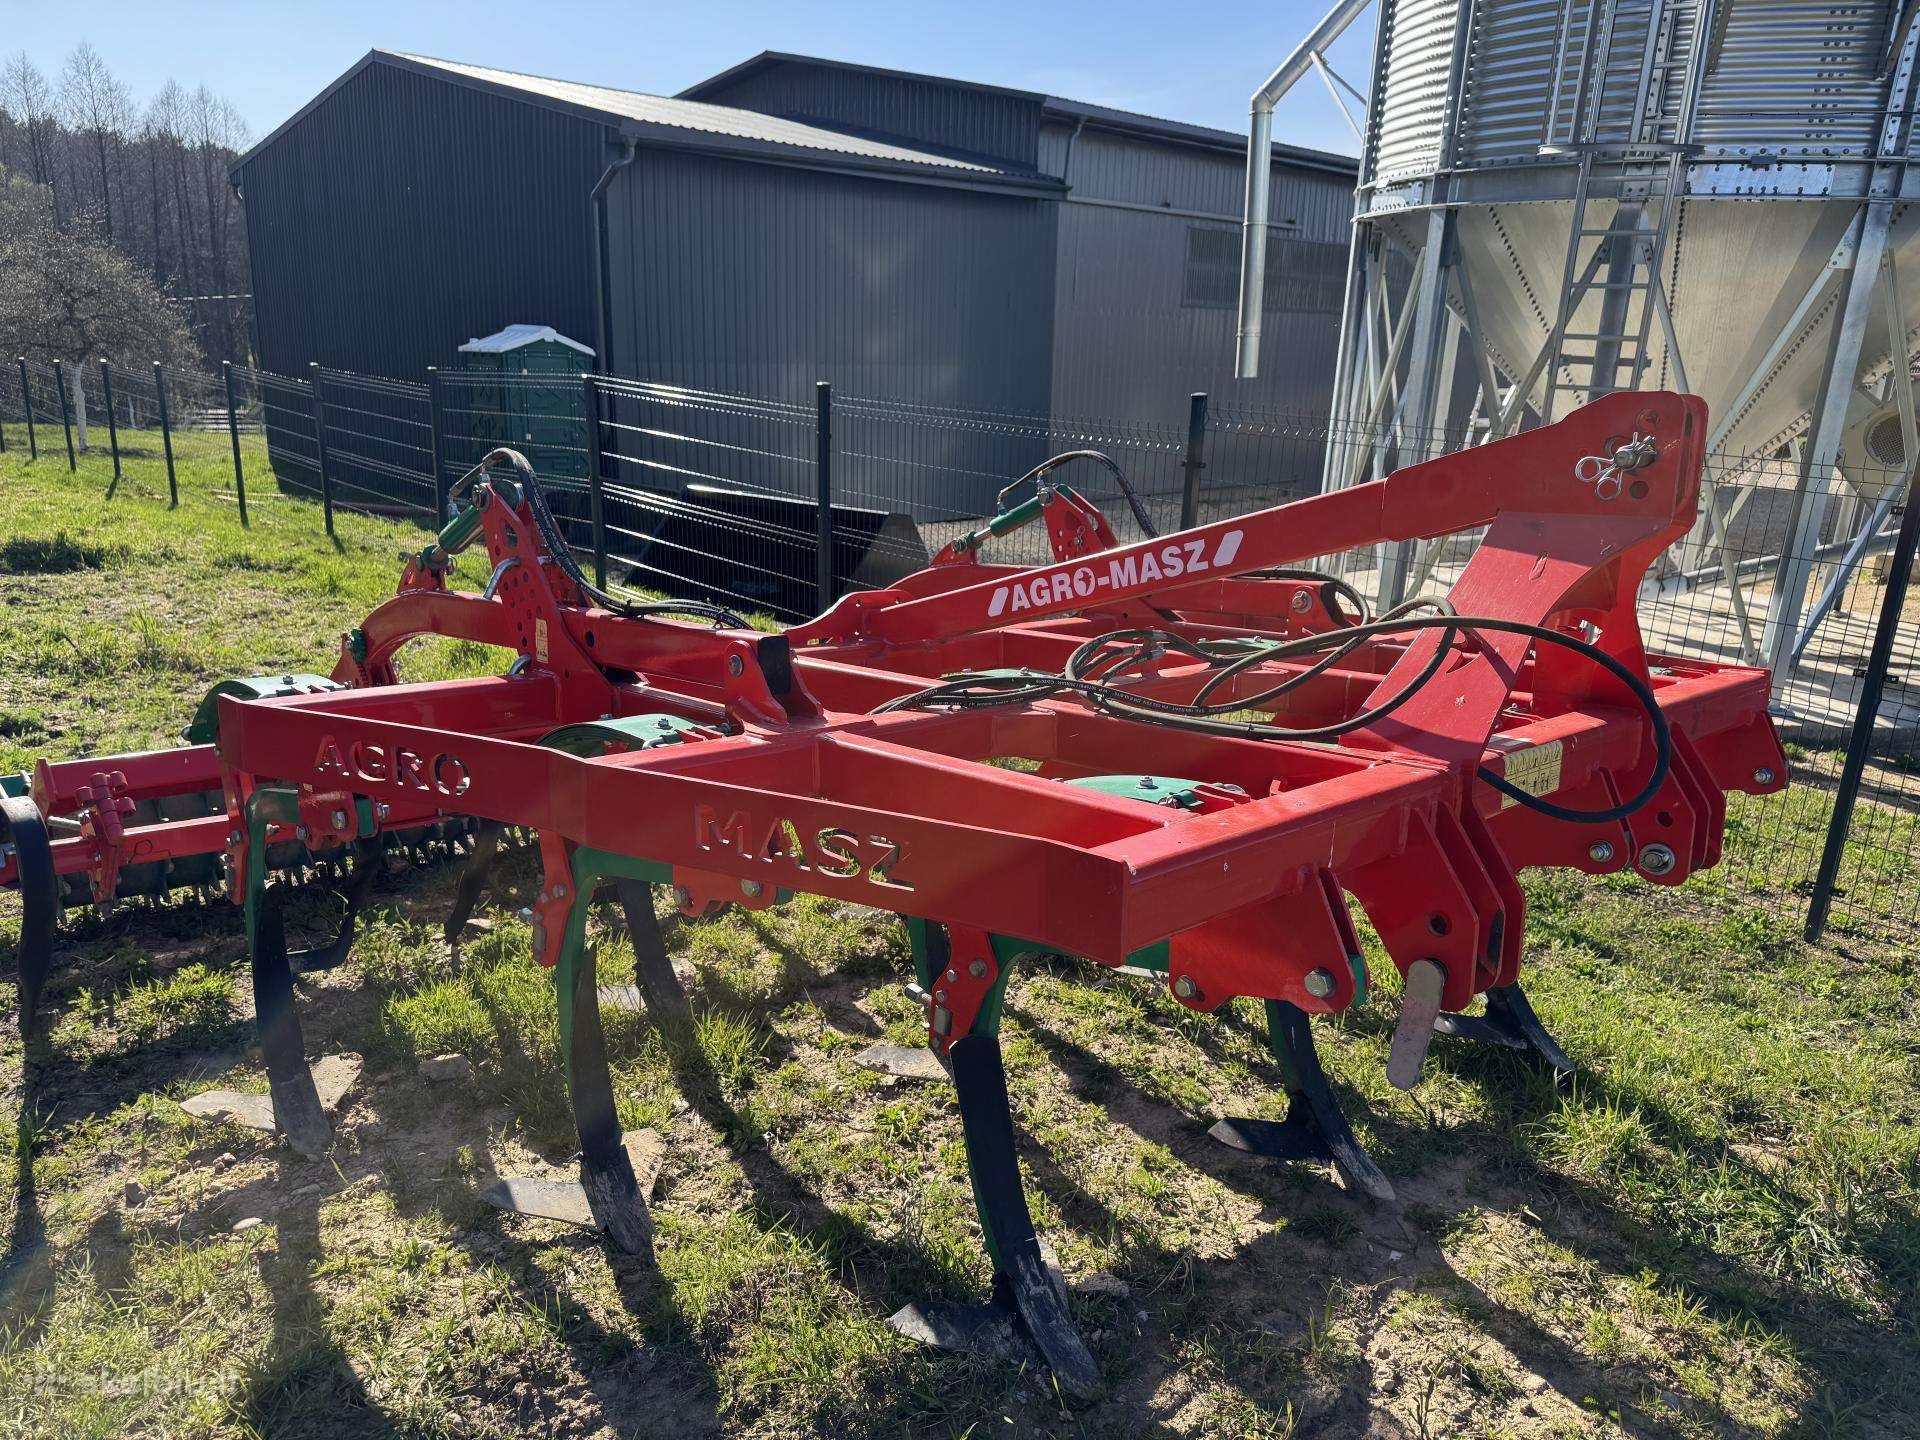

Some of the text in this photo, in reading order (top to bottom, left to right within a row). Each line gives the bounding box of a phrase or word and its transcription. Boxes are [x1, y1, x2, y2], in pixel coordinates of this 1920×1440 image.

[1011, 539, 1208, 612] AGRO-MASZ
[313, 735, 914, 891] AGRO MASZ
